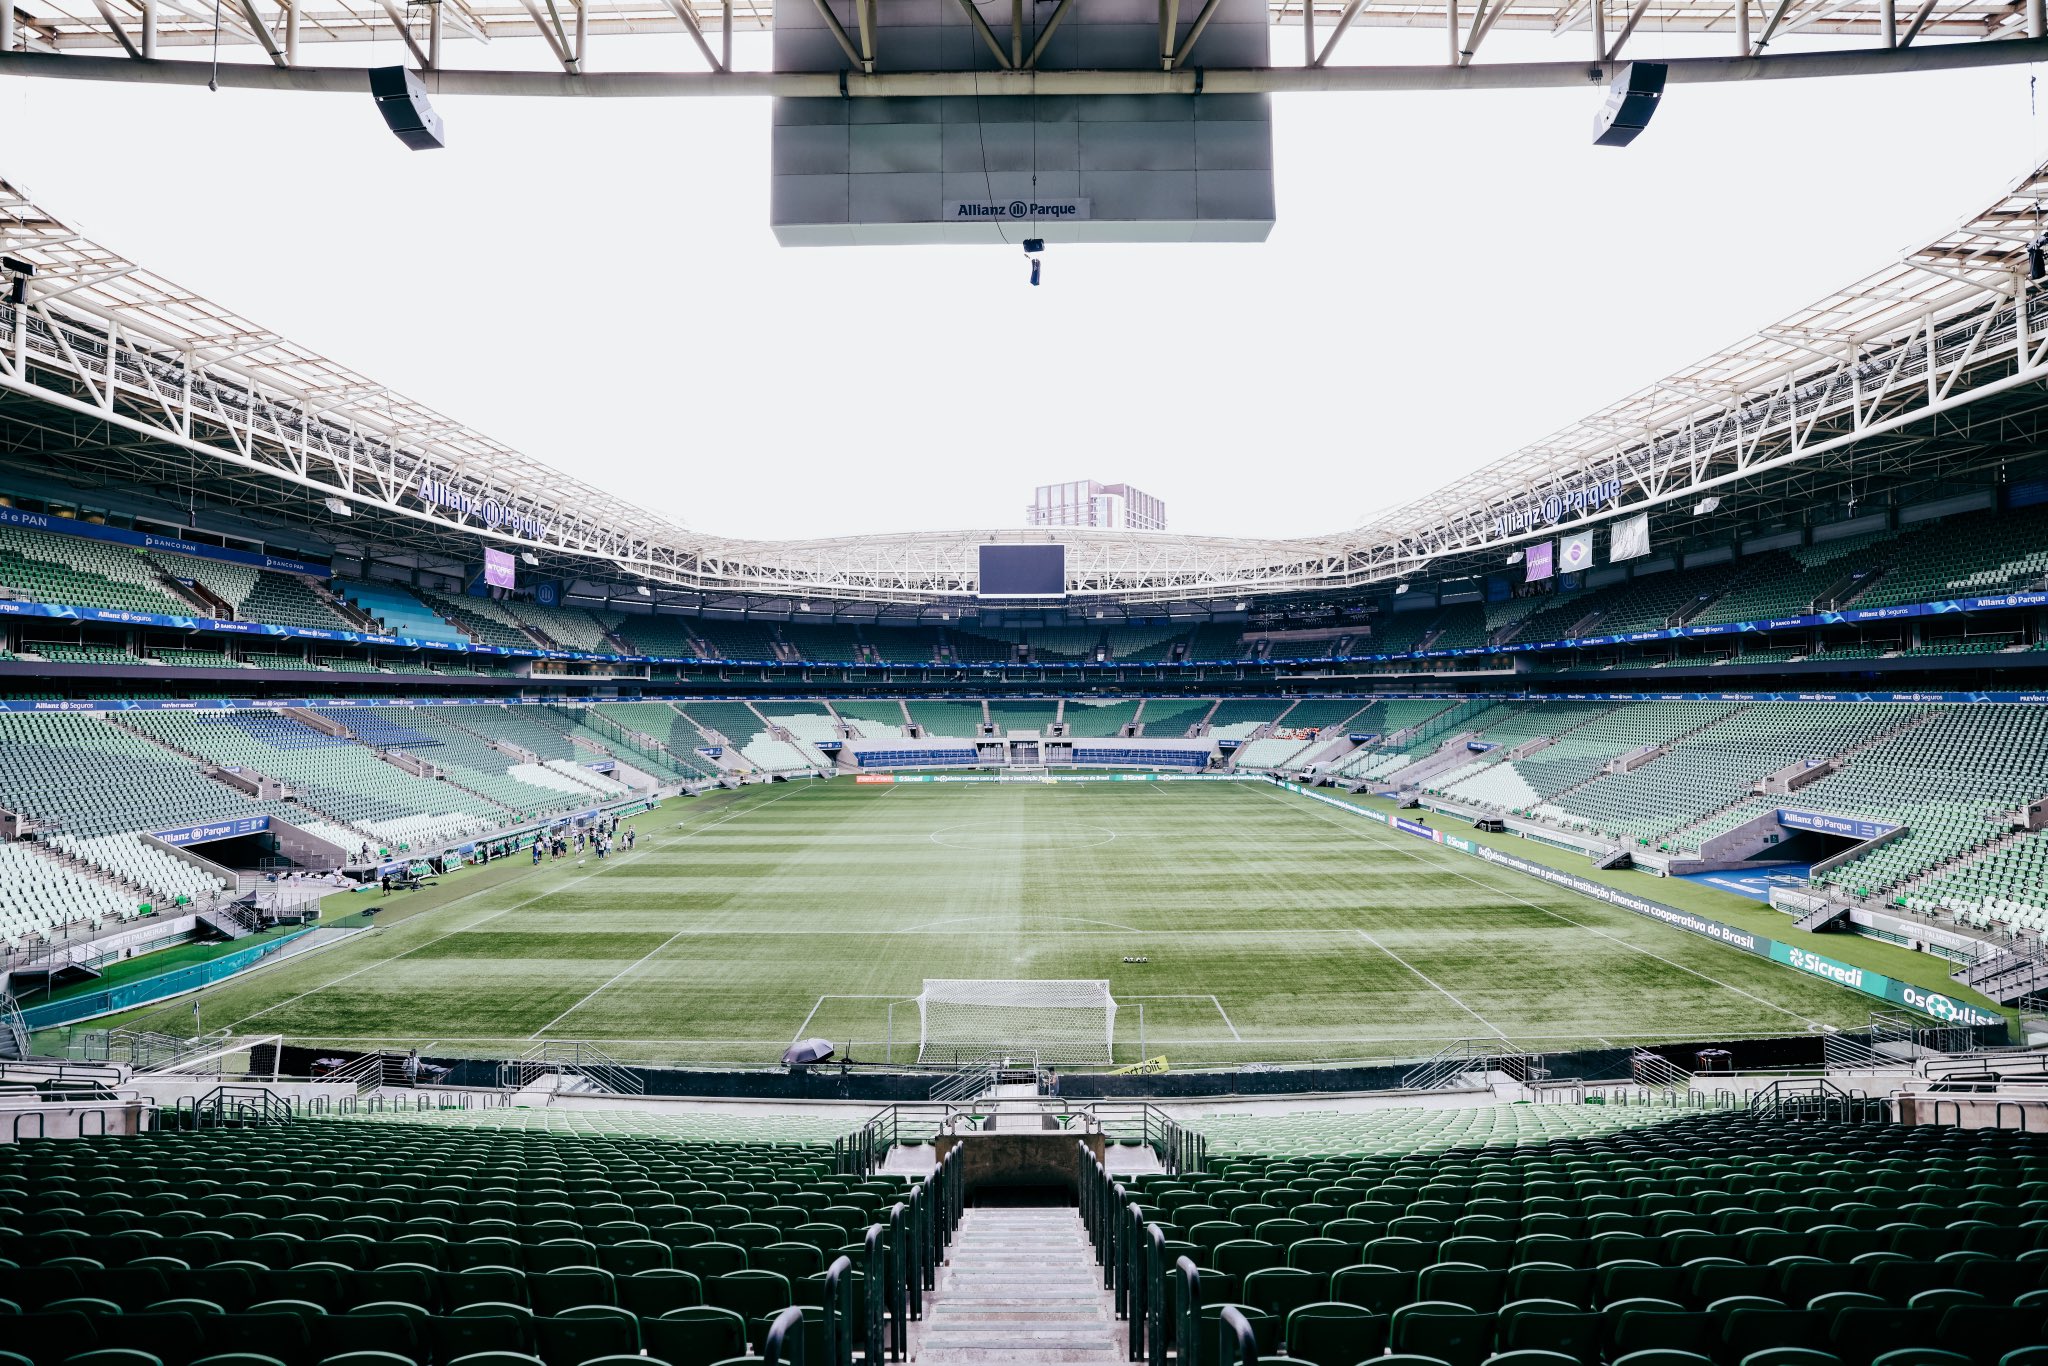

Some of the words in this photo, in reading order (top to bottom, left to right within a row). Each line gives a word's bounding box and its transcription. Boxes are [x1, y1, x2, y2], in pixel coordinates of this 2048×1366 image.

[958, 203, 1005, 216] Allianz
[1030, 203, 1076, 217] Parque
[418, 477, 480, 517] Allianz
[502, 505, 547, 540] Parque
[1494, 507, 1542, 537] Allianz
[1565, 480, 1622, 512] Parque
[22, 514, 47, 526] PAN
[154, 539, 181, 549] BANCO
[182, 543, 196, 551] PAN
[272, 560, 293, 568] BANCO
[1977, 597, 2005, 607] Allianz
[2018, 595, 2046, 605] Parque
[98, 611, 120, 619] Allianz
[130, 614, 152, 622] Seguros
[1887, 608, 1908, 617] Seguros
[70, 702, 93, 710] Seguros
[1784, 812, 1812, 824] Allianz
[1824, 819, 1852, 831] Parque
[203, 825, 231, 836] Parque
[1508, 859, 1527, 871] contam
[1528, 865, 1540, 875] com
[1545, 870, 1572, 885] primeira
[1573, 878, 1609, 899] instituição
[1609, 890, 1650, 913] financeira
[1650, 906, 1705, 932] cooperativa
[1707, 924, 1720, 937] do
[1722, 927, 1754, 949] Brasil
[131, 926, 167, 943] PALMEIRAS
[1924, 930, 1960, 946] PALMEIRAS
[1804, 953, 1862, 987] Sicredi
[1903, 988, 1925, 1007] Os
